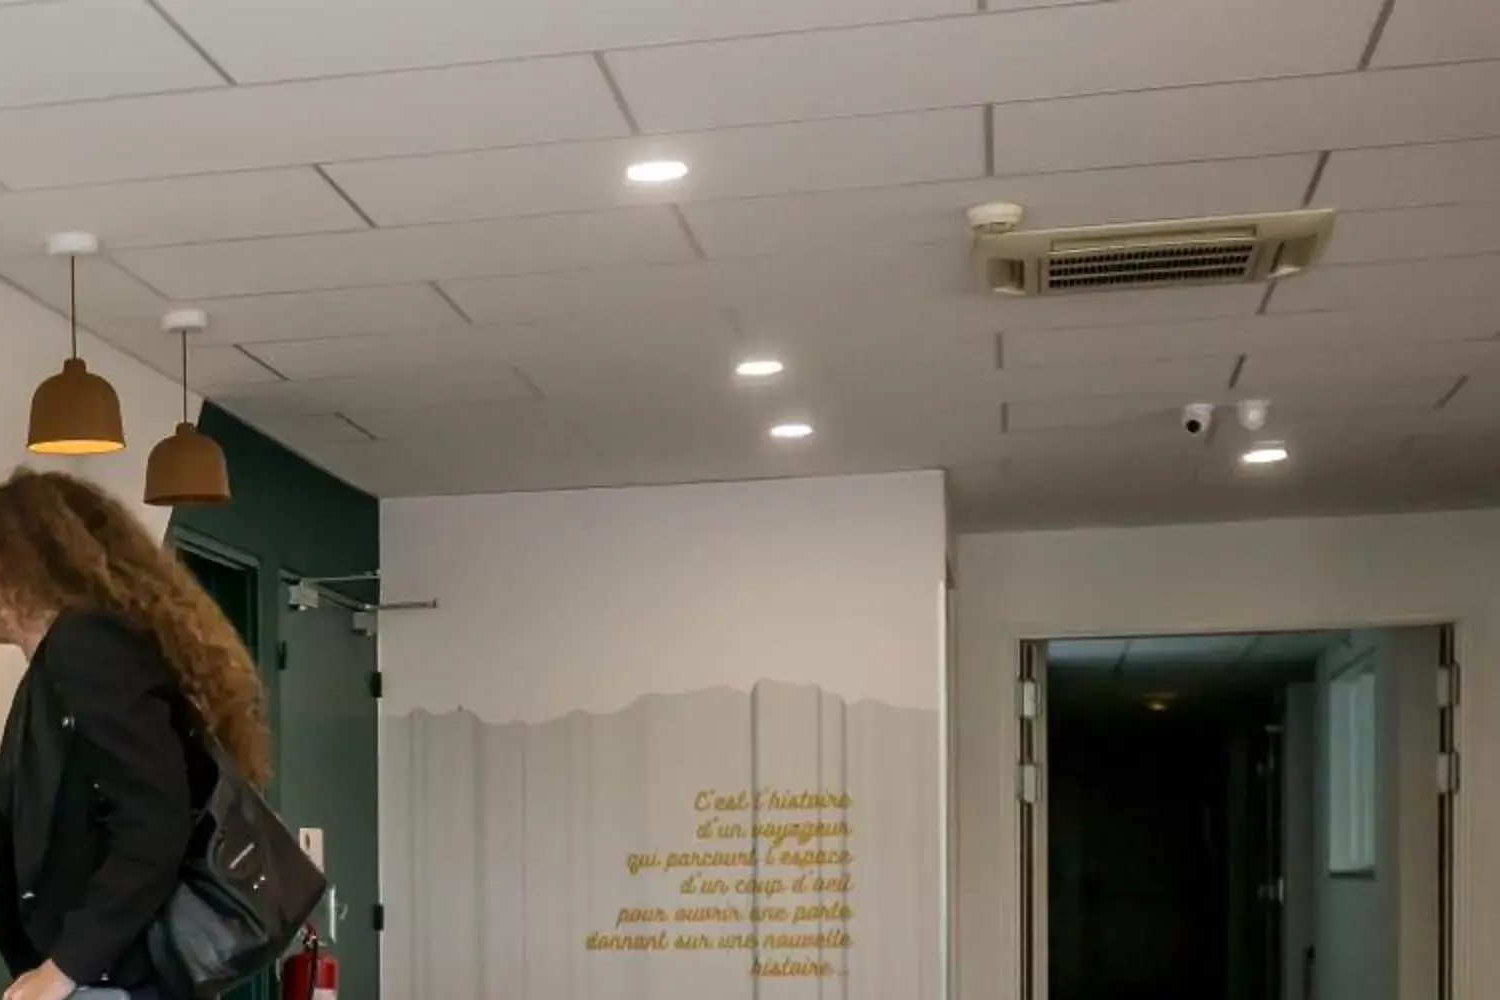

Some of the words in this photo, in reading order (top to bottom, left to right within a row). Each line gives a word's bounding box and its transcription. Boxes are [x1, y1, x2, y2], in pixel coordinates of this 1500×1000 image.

[693, 788, 749, 811] C'est
[753, 787, 853, 811] l'histoire
[695, 816, 747, 839] d'un
[627, 853, 661, 874] qui
[664, 848, 757, 871] parcourt
[765, 848, 853, 872] l'espace
[679, 871, 730, 895] d'un
[735, 877, 785, 898] coup
[616, 905, 669, 928] pour
[674, 902, 742, 922] ouvrir
[749, 906, 788, 922] une
[791, 902, 854, 925] porte
[585, 930, 668, 951] donnant
[673, 933, 713, 950] sur
[717, 933, 760, 950] une
[762, 929, 854, 950] nouvelle
